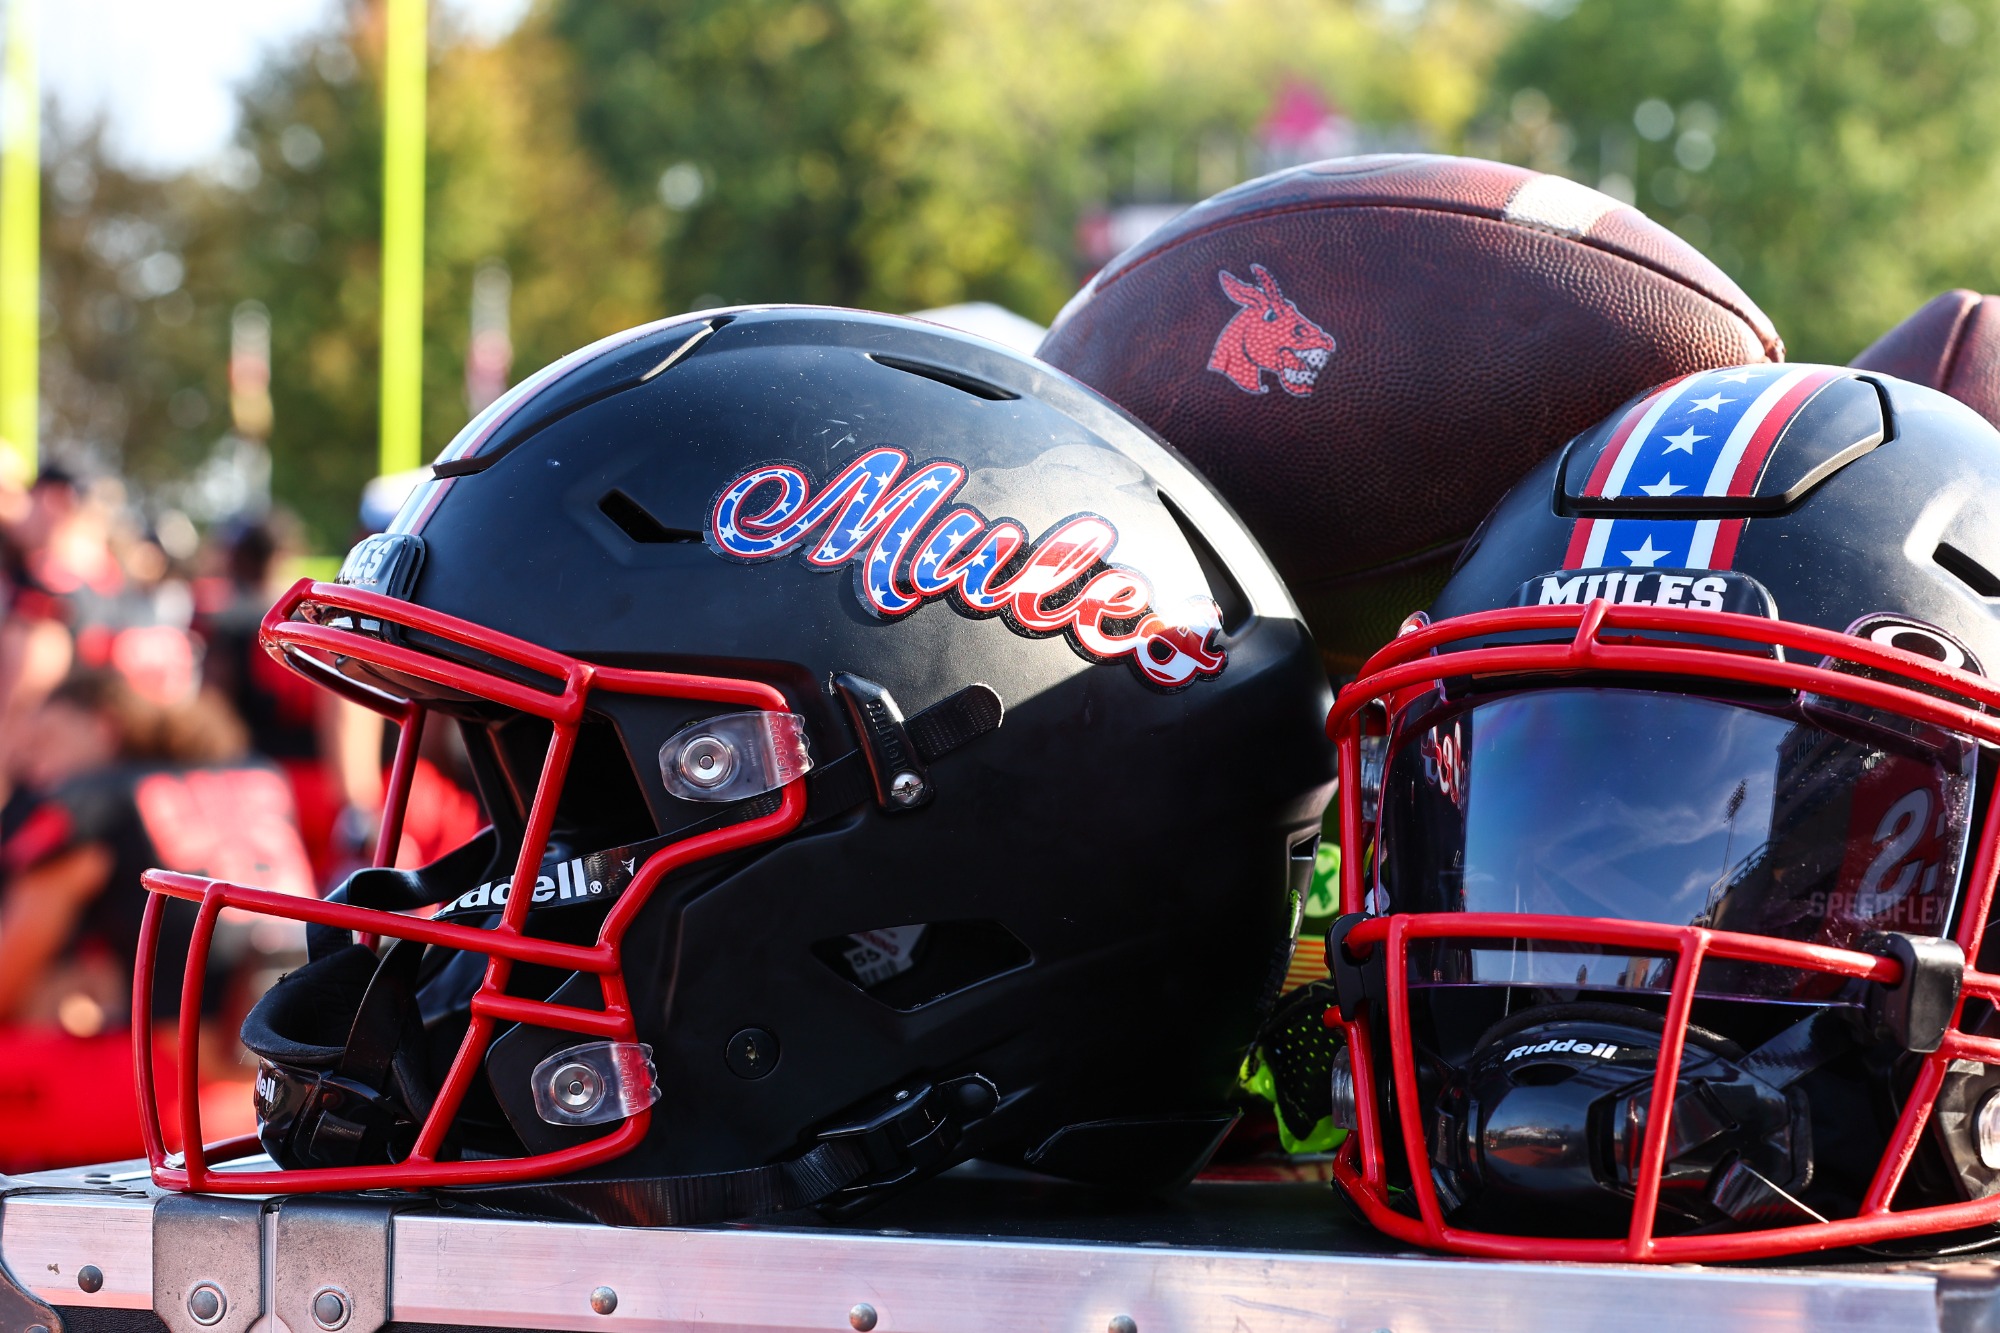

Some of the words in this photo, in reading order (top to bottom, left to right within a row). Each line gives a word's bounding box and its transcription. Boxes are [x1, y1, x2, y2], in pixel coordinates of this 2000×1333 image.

[711, 446, 1226, 688] Mules
[1538, 574, 1728, 612] MULES
[446, 857, 588, 911] ddell
[1809, 890, 1947, 926] SPEEDFLEX
[1504, 1039, 1618, 1061] Riddell
